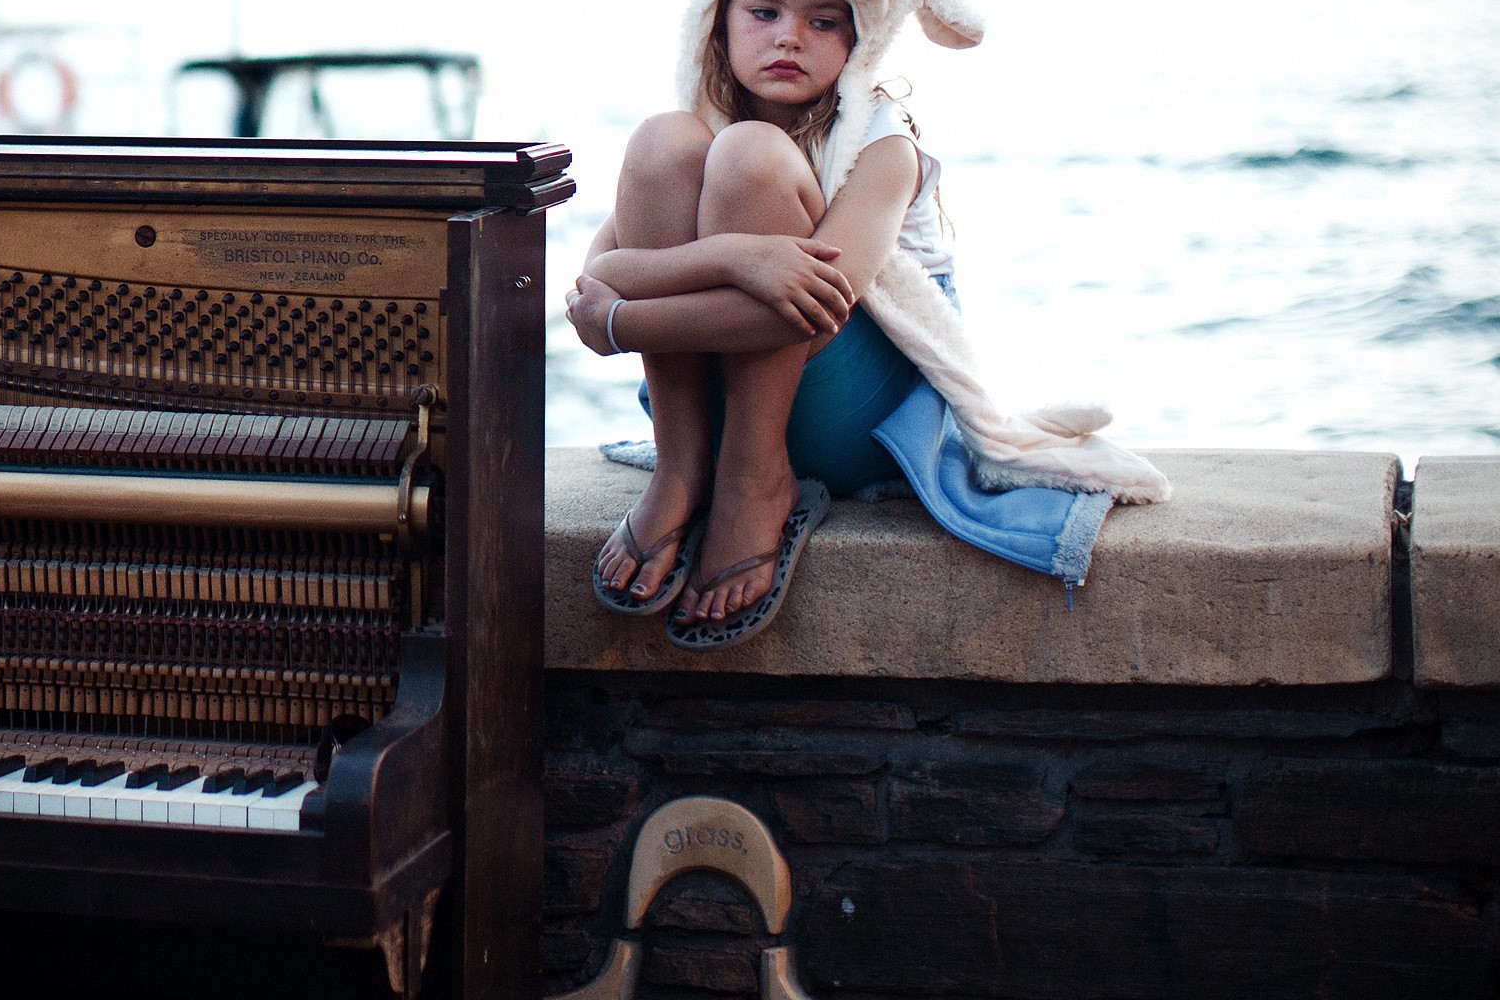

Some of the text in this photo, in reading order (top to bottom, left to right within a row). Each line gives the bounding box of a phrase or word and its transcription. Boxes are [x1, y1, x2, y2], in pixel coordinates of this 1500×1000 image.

[199, 231, 406, 245] SPECIALLY CONSTRUCTED FOR THE
[224, 248, 383, 266] BRISTOL PIANO Co.
[259, 271, 345, 282] NEW ZEALAND
